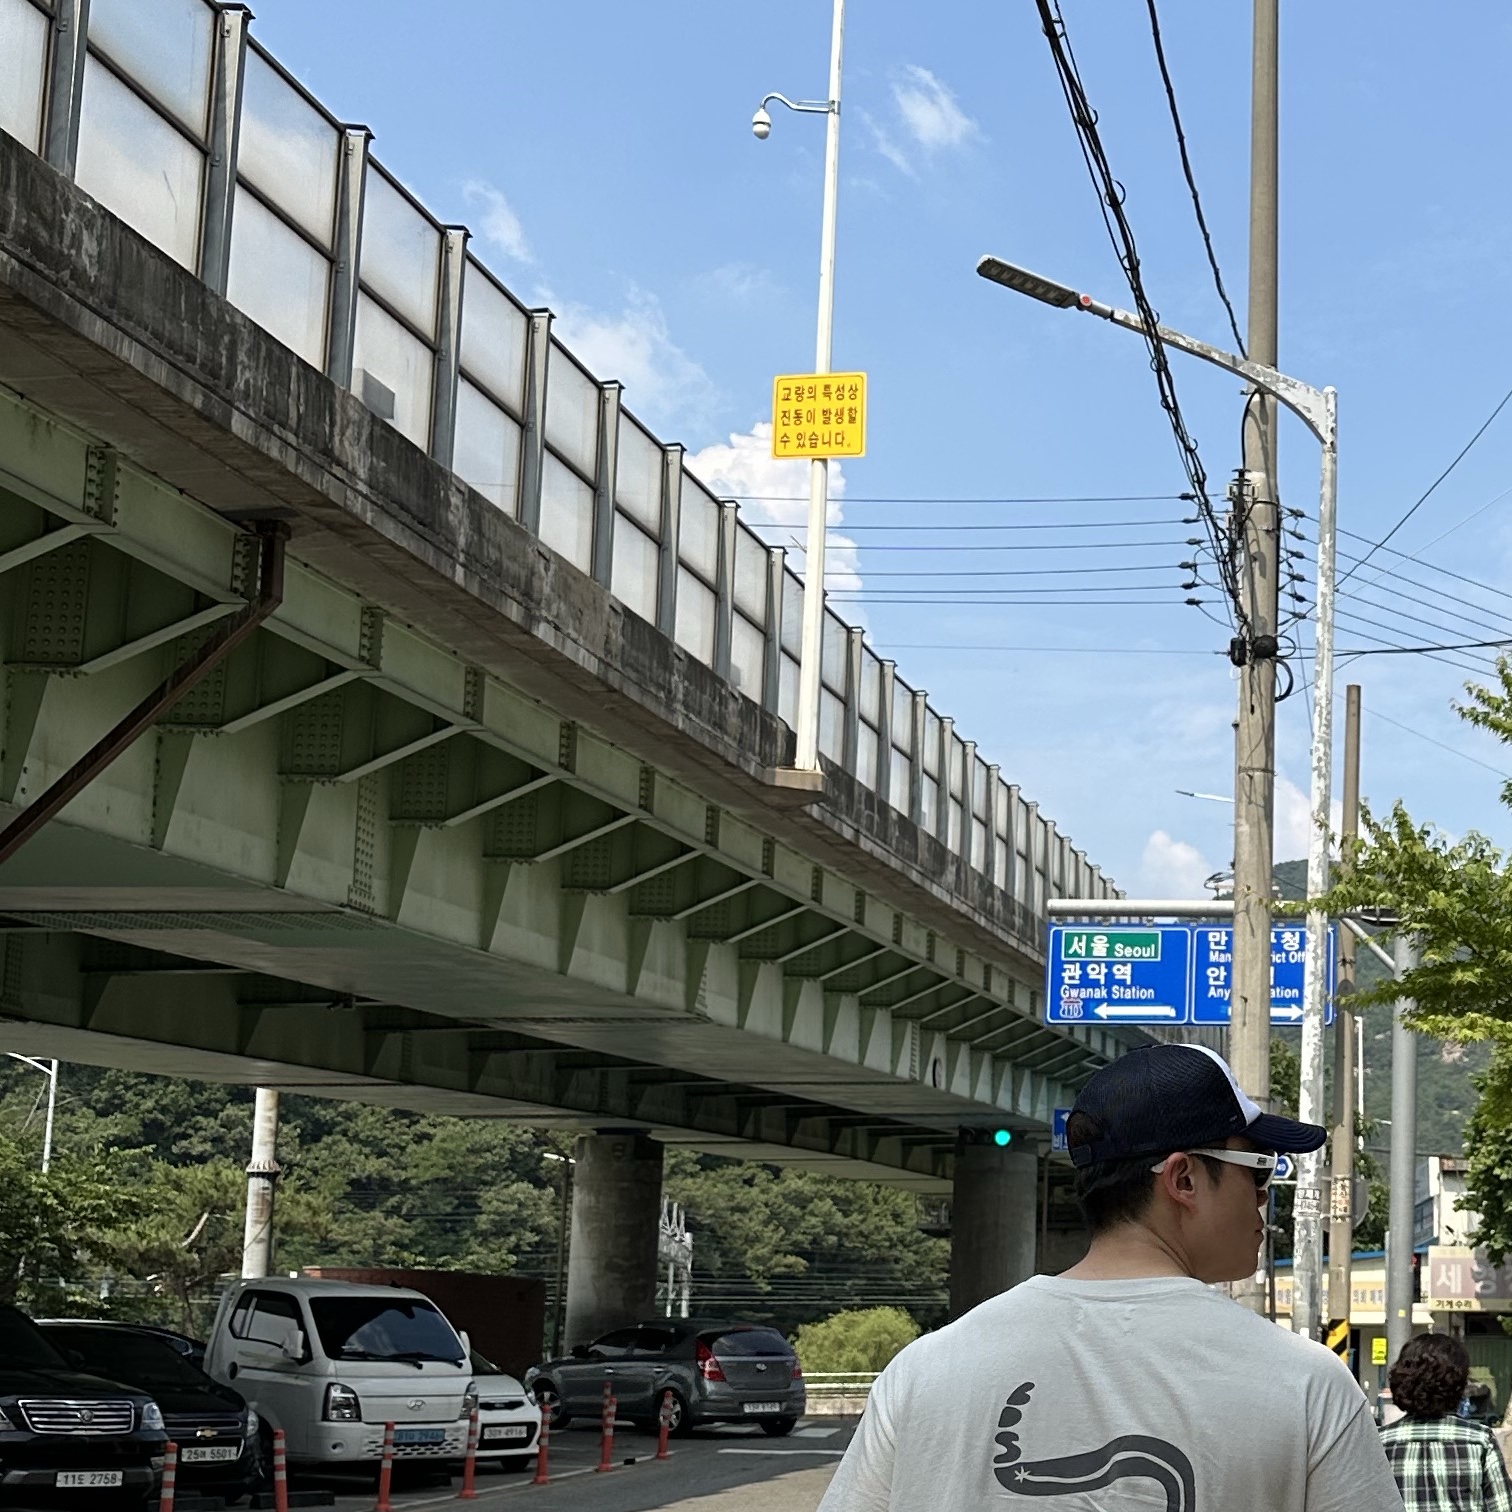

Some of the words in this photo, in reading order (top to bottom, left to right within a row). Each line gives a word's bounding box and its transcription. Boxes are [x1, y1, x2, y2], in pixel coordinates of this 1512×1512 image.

[781, 385, 817, 402] 교량의
[822, 384, 858, 401] 특성상
[781, 409, 815, 426] 진동이
[822, 407, 857, 425] 발생할
[780, 433, 790, 449] 수
[796, 431, 851, 449] 있습니다.
[1068, 935, 1110, 957] 서울
[1114, 942, 1156, 959] Seoul
[1061, 963, 1132, 985] 관악역
[1060, 985, 1107, 999] Gwanak
[1111, 985, 1155, 999] Station
